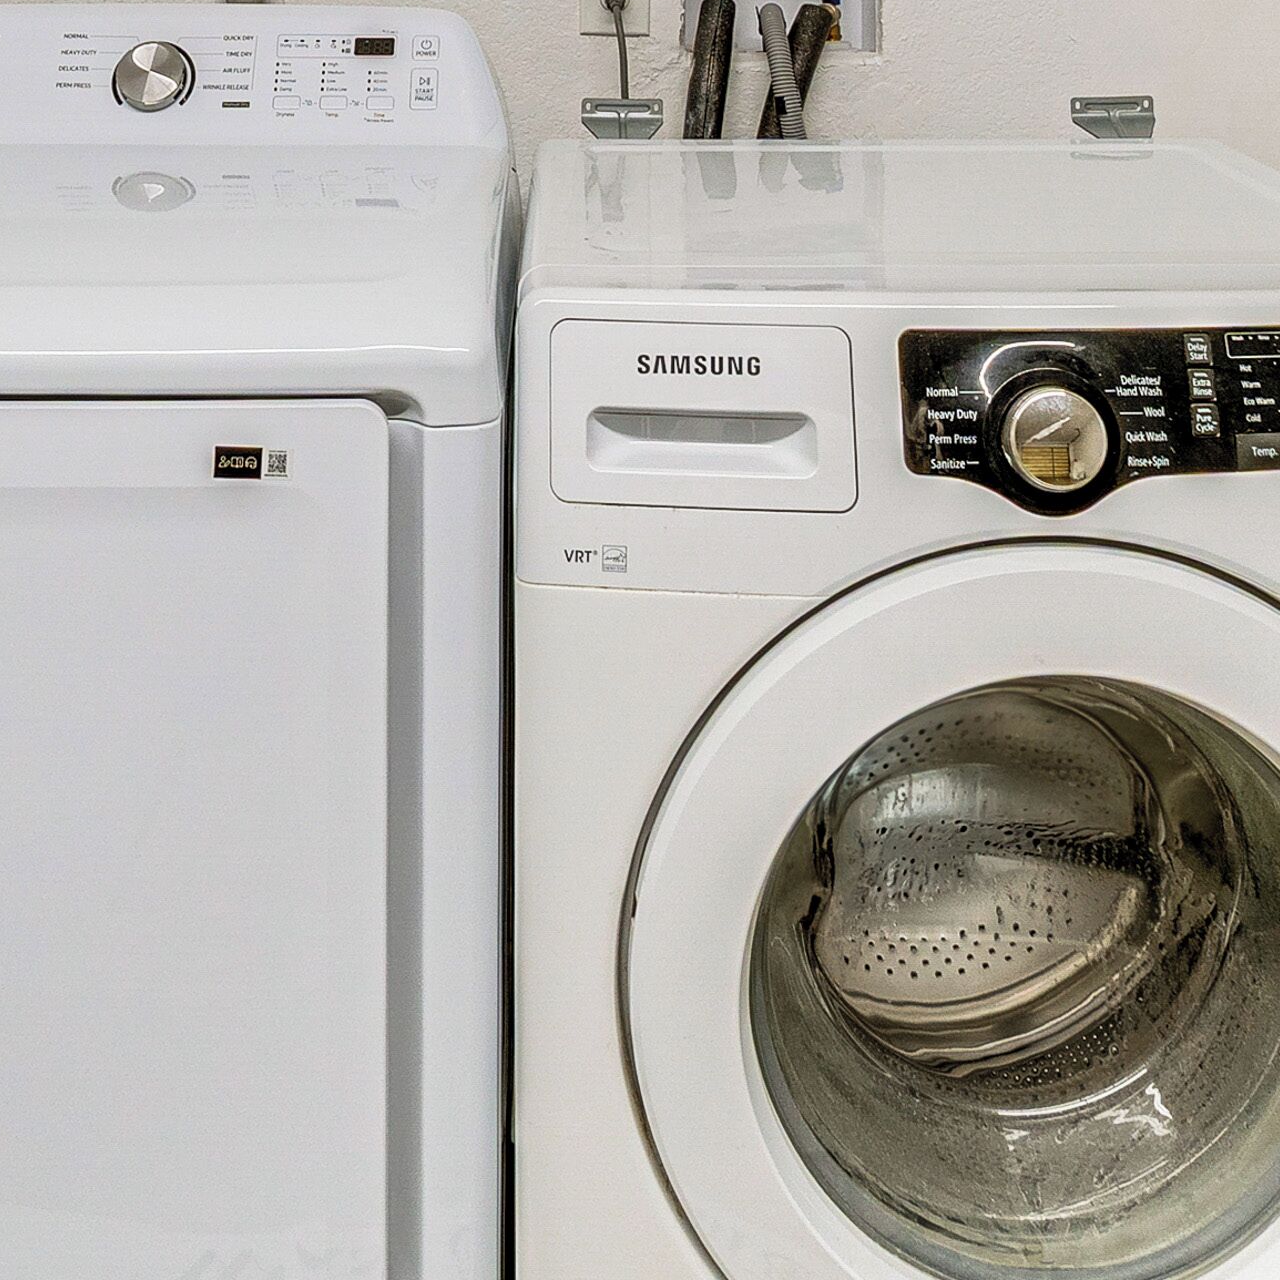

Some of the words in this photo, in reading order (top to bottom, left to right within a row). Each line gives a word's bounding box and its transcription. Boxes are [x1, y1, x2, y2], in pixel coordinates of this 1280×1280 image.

[1187, 343, 1207, 352] Delay
[1190, 352, 1208, 360] Start
[637, 354, 761, 376] SAMSUNG
[1239, 364, 1252, 372] Hot
[1120, 374, 1161, 386] Delicates/
[1192, 378, 1211, 387] Extra
[1241, 380, 1261, 389] Warm
[925, 386, 959, 397] Normal
[1115, 386, 1138, 397] Hand
[1138, 386, 1163, 397] Wash
[1193, 388, 1213, 396] Rinse
[1243, 397, 1255, 406] Eco
[1255, 397, 1275, 405] Warm
[927, 409, 955, 422] Heavy
[956, 409, 978, 421] Duty
[1143, 406, 1165, 417] Wool
[1195, 413, 1212, 422] Pure
[1245, 413, 1262, 422] Cold
[929, 433, 952, 444] Perm
[953, 433, 977, 444] Press
[1125, 431, 1146, 443] Quick
[1145, 431, 1168, 442] Wash
[1251, 446, 1279, 458] Temp.
[930, 458, 966, 469] Sanitize
[1127, 455, 1170, 469] Rinse+Spin
